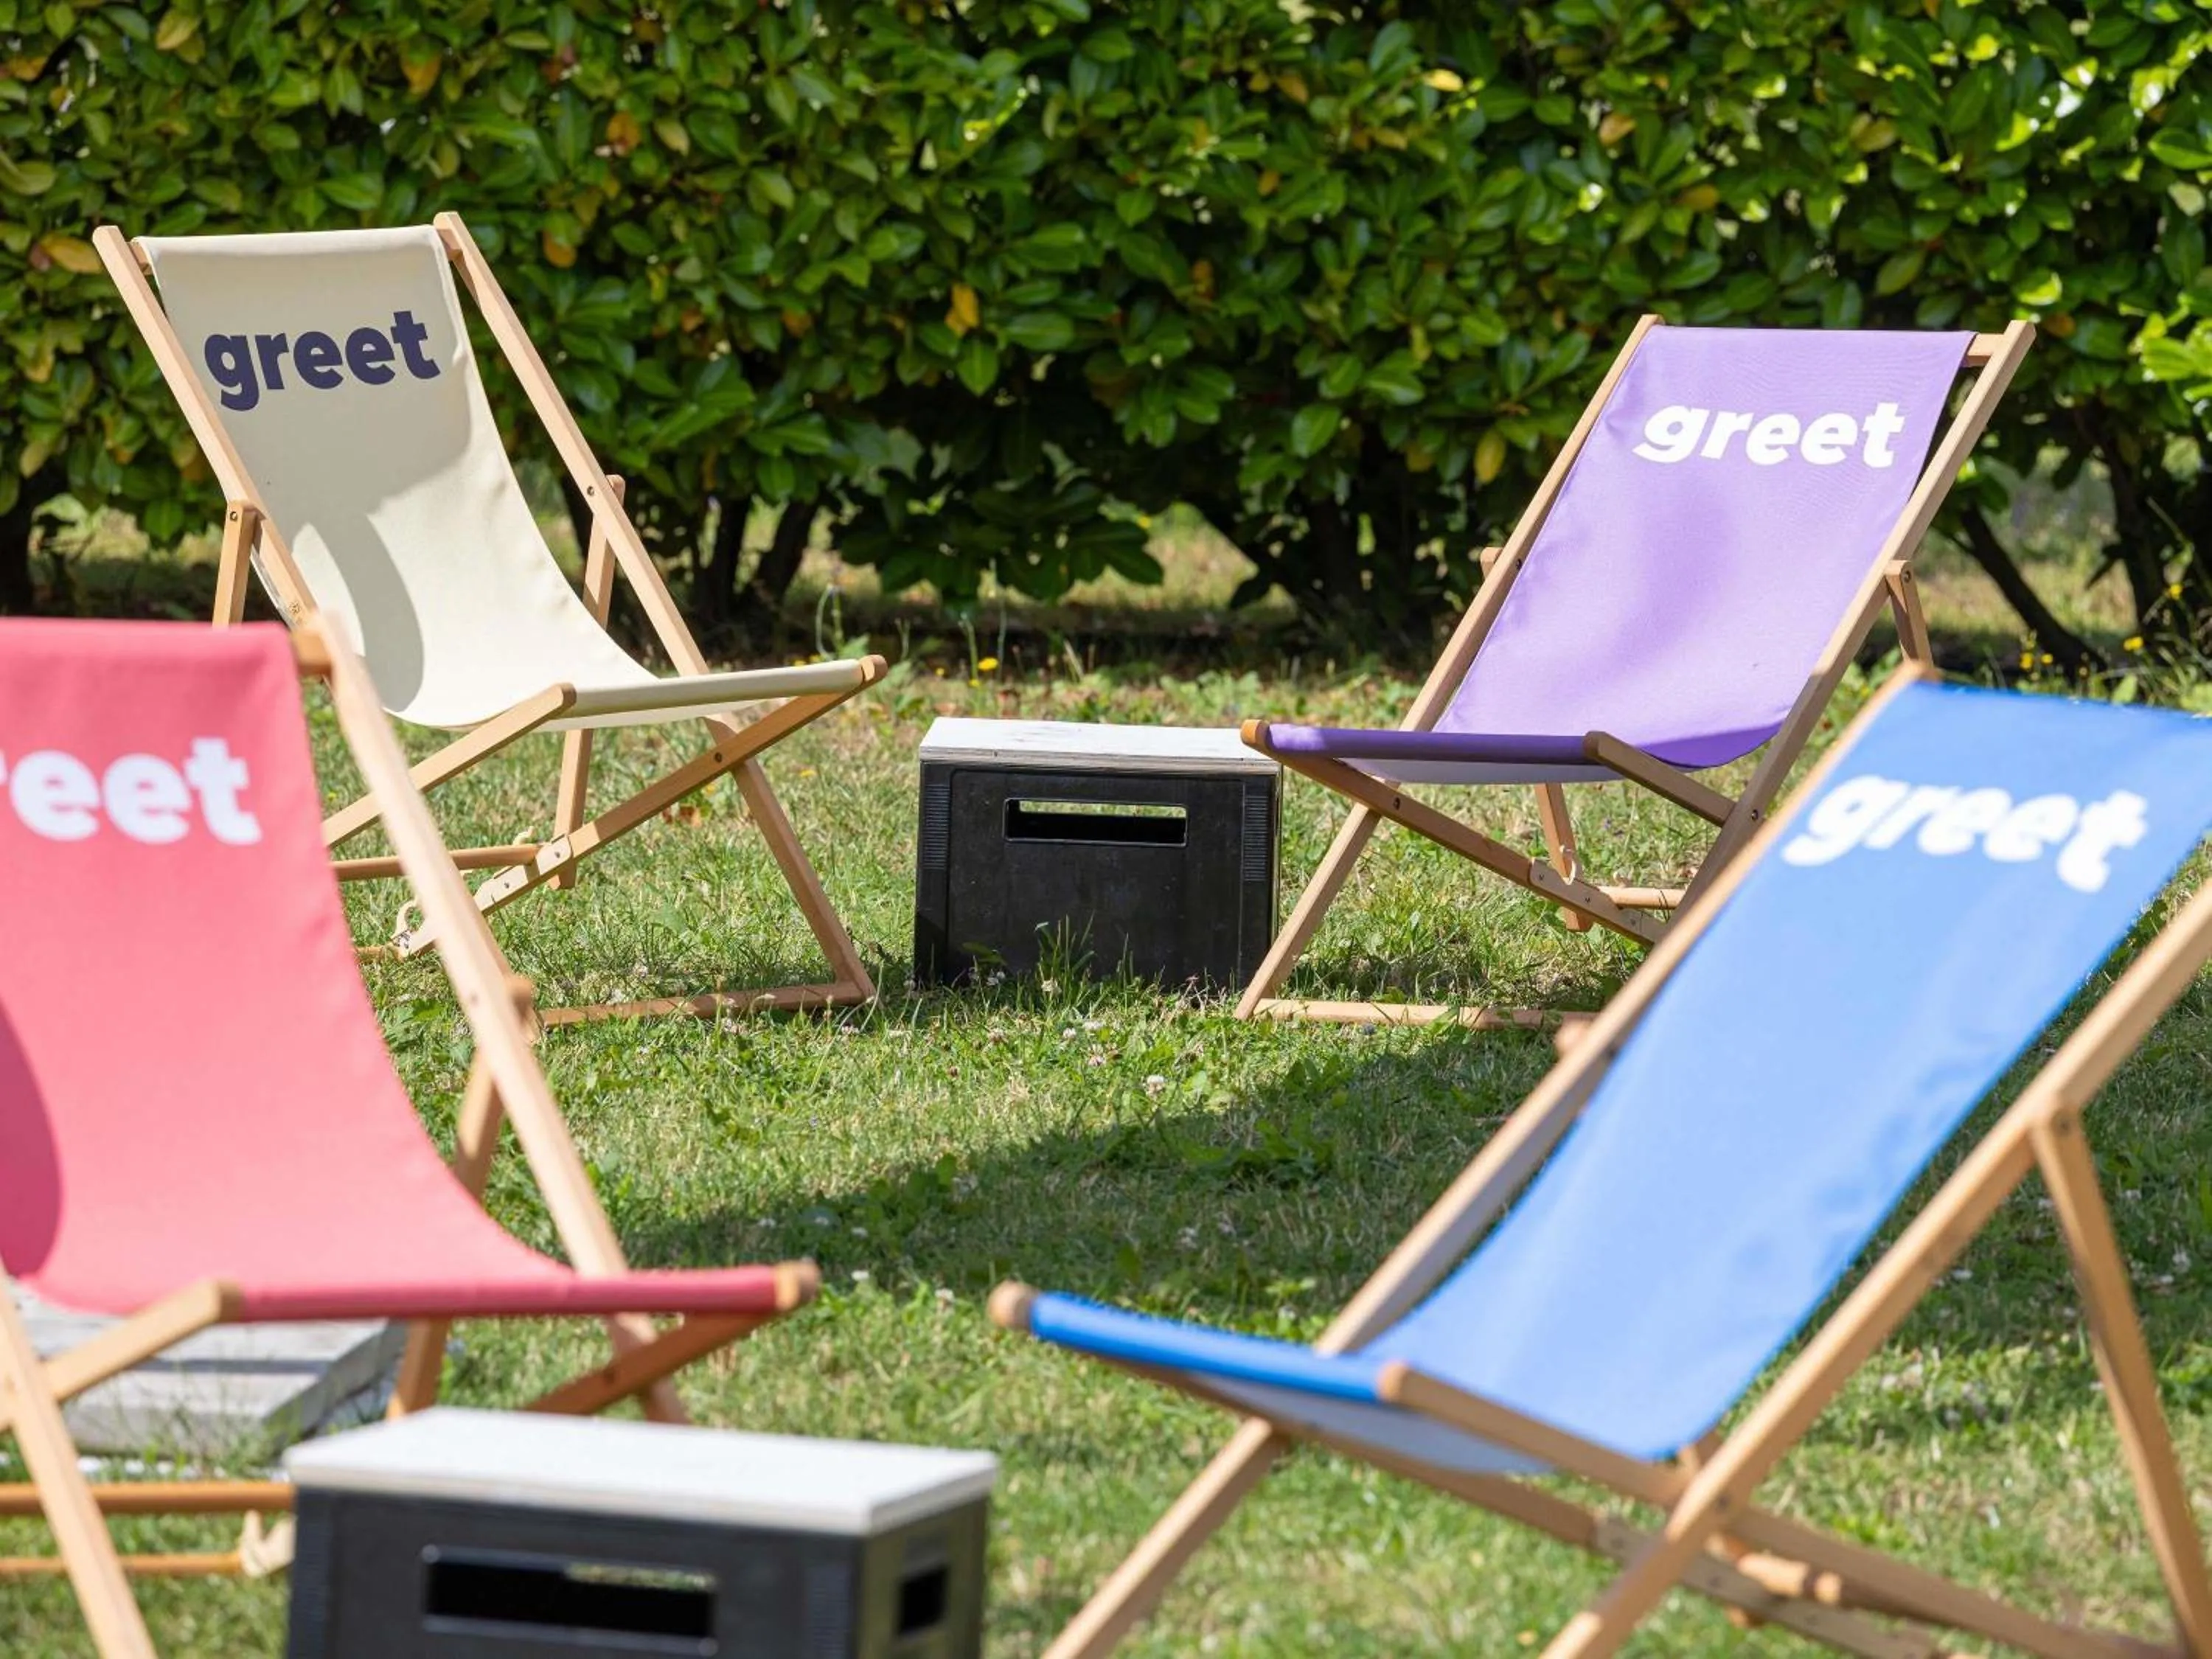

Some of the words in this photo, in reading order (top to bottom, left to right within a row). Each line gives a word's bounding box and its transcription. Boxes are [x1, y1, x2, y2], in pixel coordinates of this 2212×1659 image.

[204, 310, 441, 411] greet
[1632, 403, 1905, 468] greet
[0, 736, 262, 846] eet
[1781, 775, 2146, 893] greet
